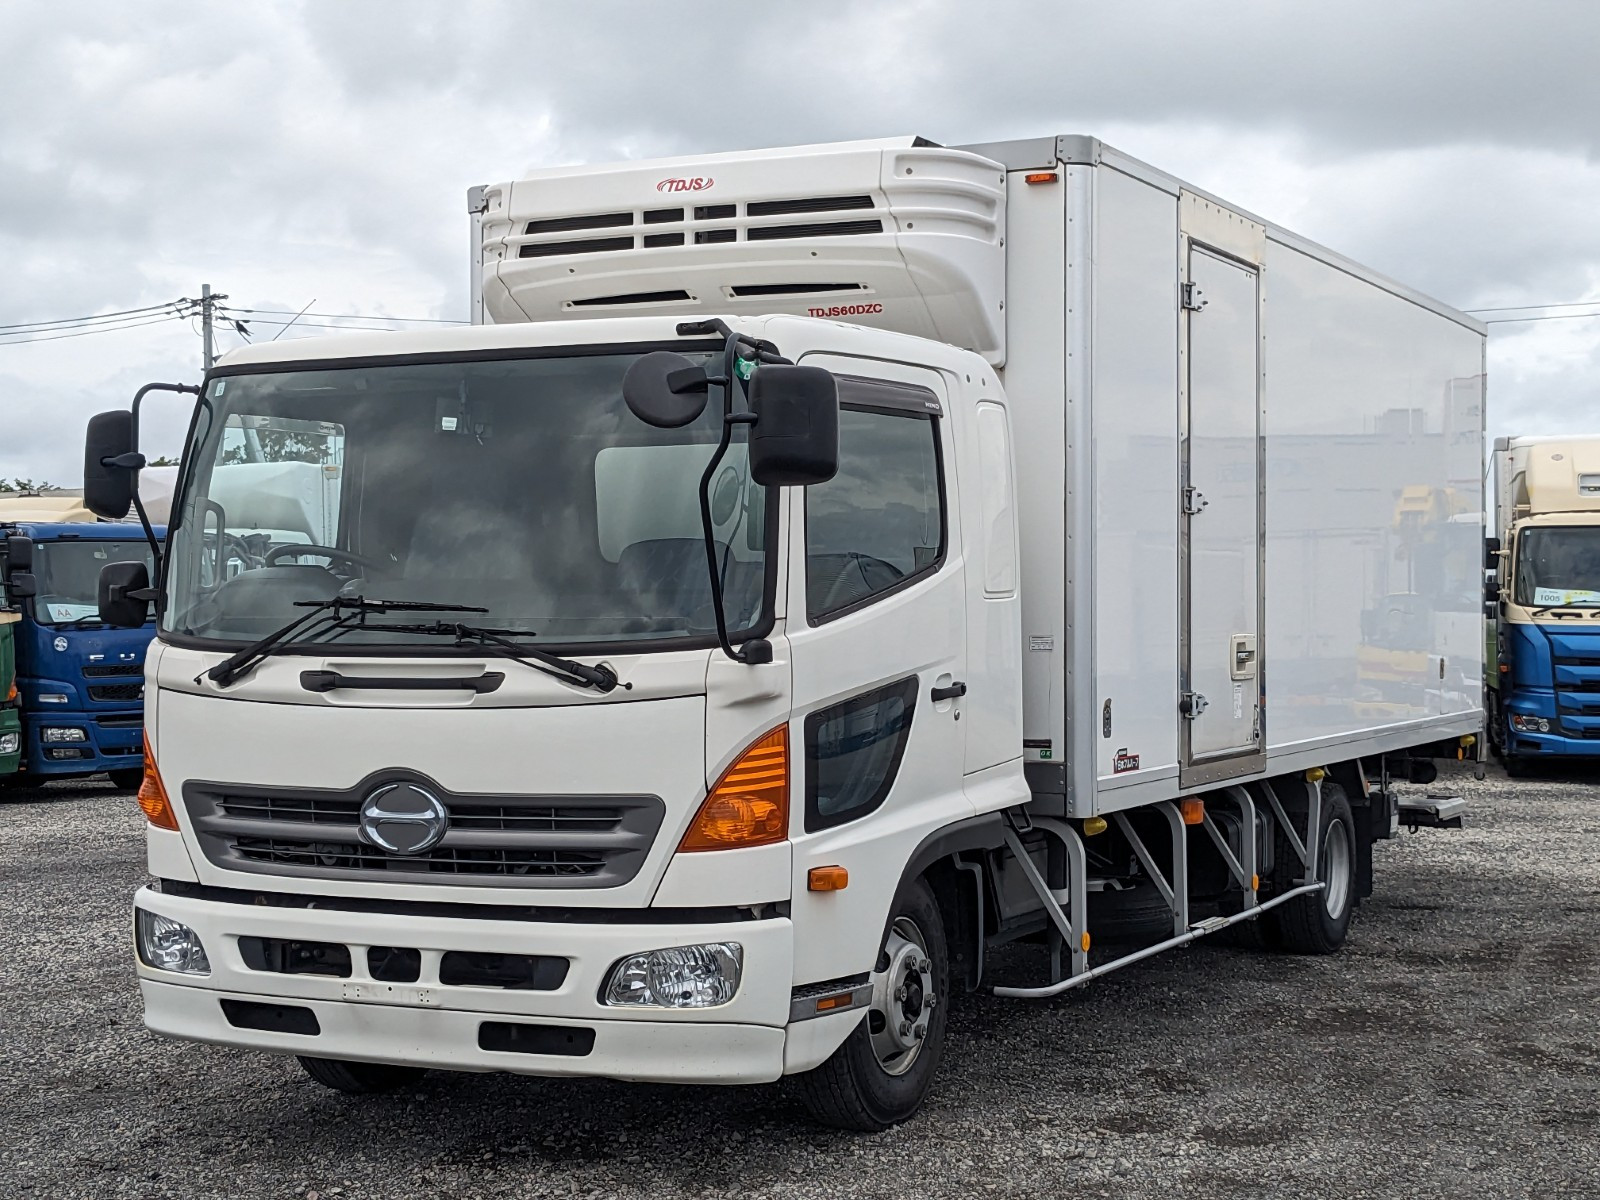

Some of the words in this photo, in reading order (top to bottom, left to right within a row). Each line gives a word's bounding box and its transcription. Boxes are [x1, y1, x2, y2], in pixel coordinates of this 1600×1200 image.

[667, 177, 704, 192] TDJS
[808, 303, 883, 317] TDJS60DZC
[1540, 594, 1561, 602] 1005
[57, 608, 72, 617] AA
